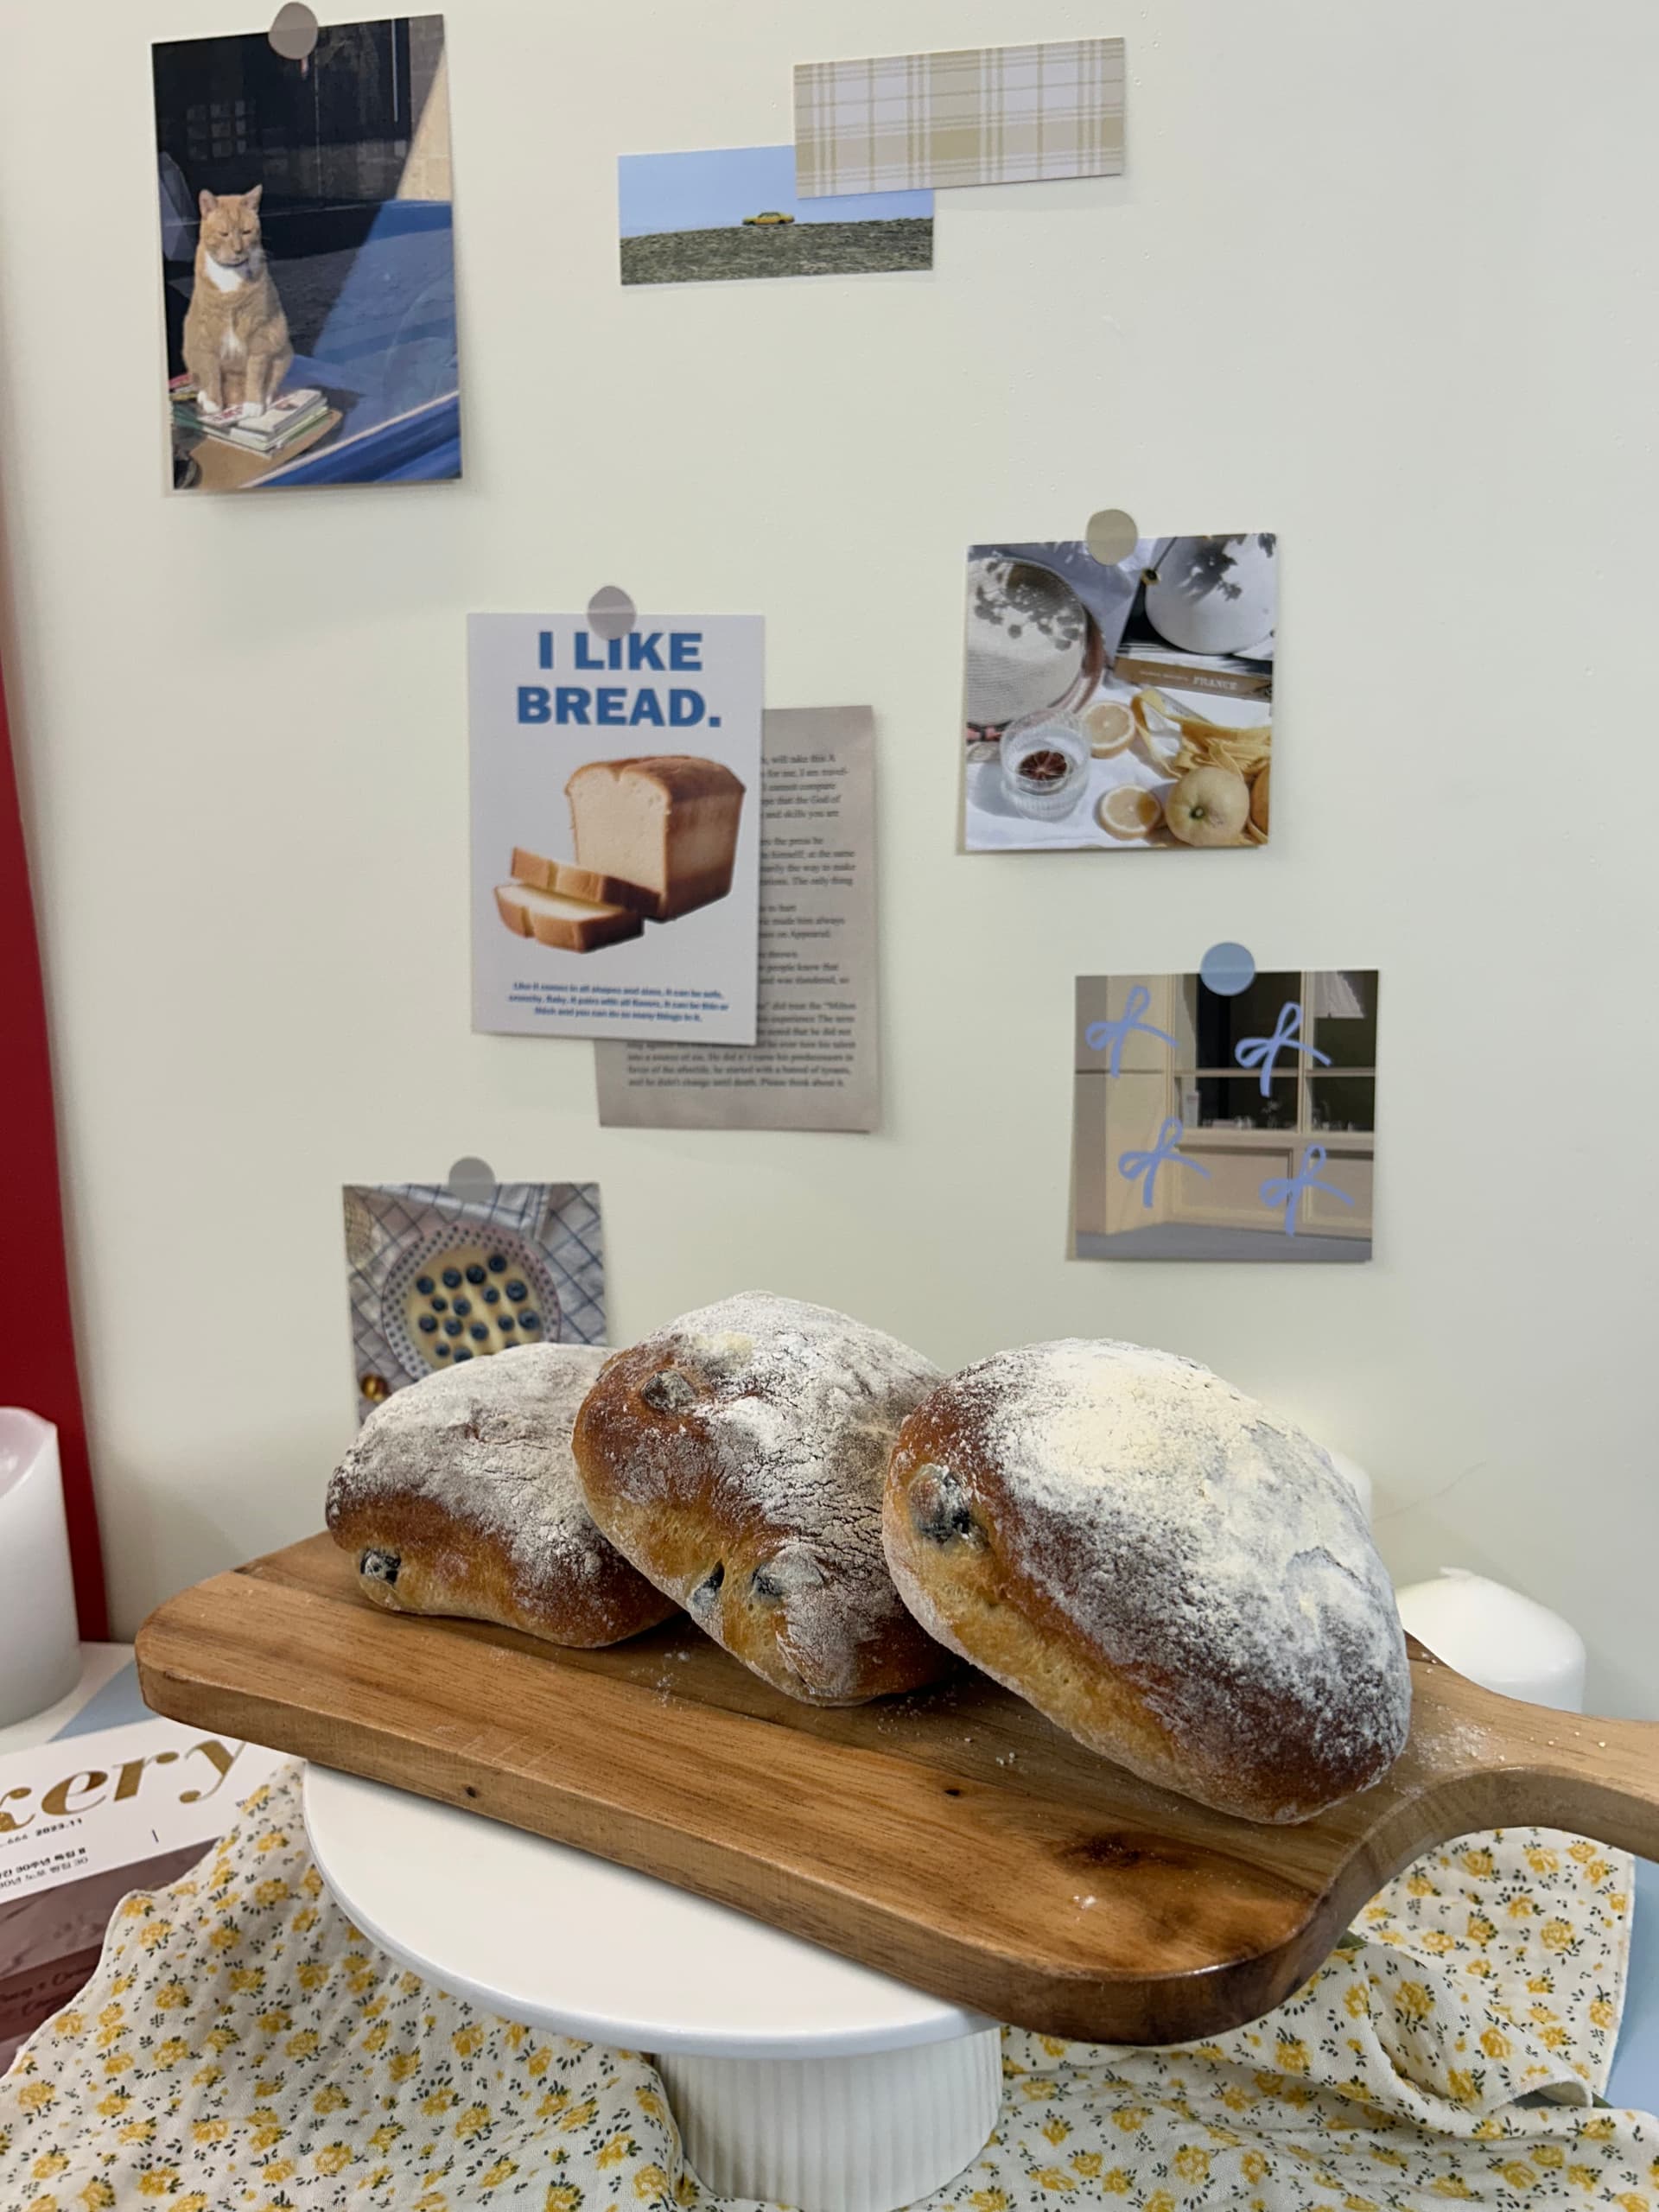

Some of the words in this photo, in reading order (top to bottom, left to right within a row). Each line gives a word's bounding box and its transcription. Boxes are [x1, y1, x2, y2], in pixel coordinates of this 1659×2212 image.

[539, 631, 554, 670] I
[575, 631, 702, 671] LIKE
[1192, 675, 1237, 690] FRANCE
[518, 686, 721, 728] BREAD.
[35, 1817, 83, 1837] 2023.11
[16, 1857, 51, 1873] 30주년
